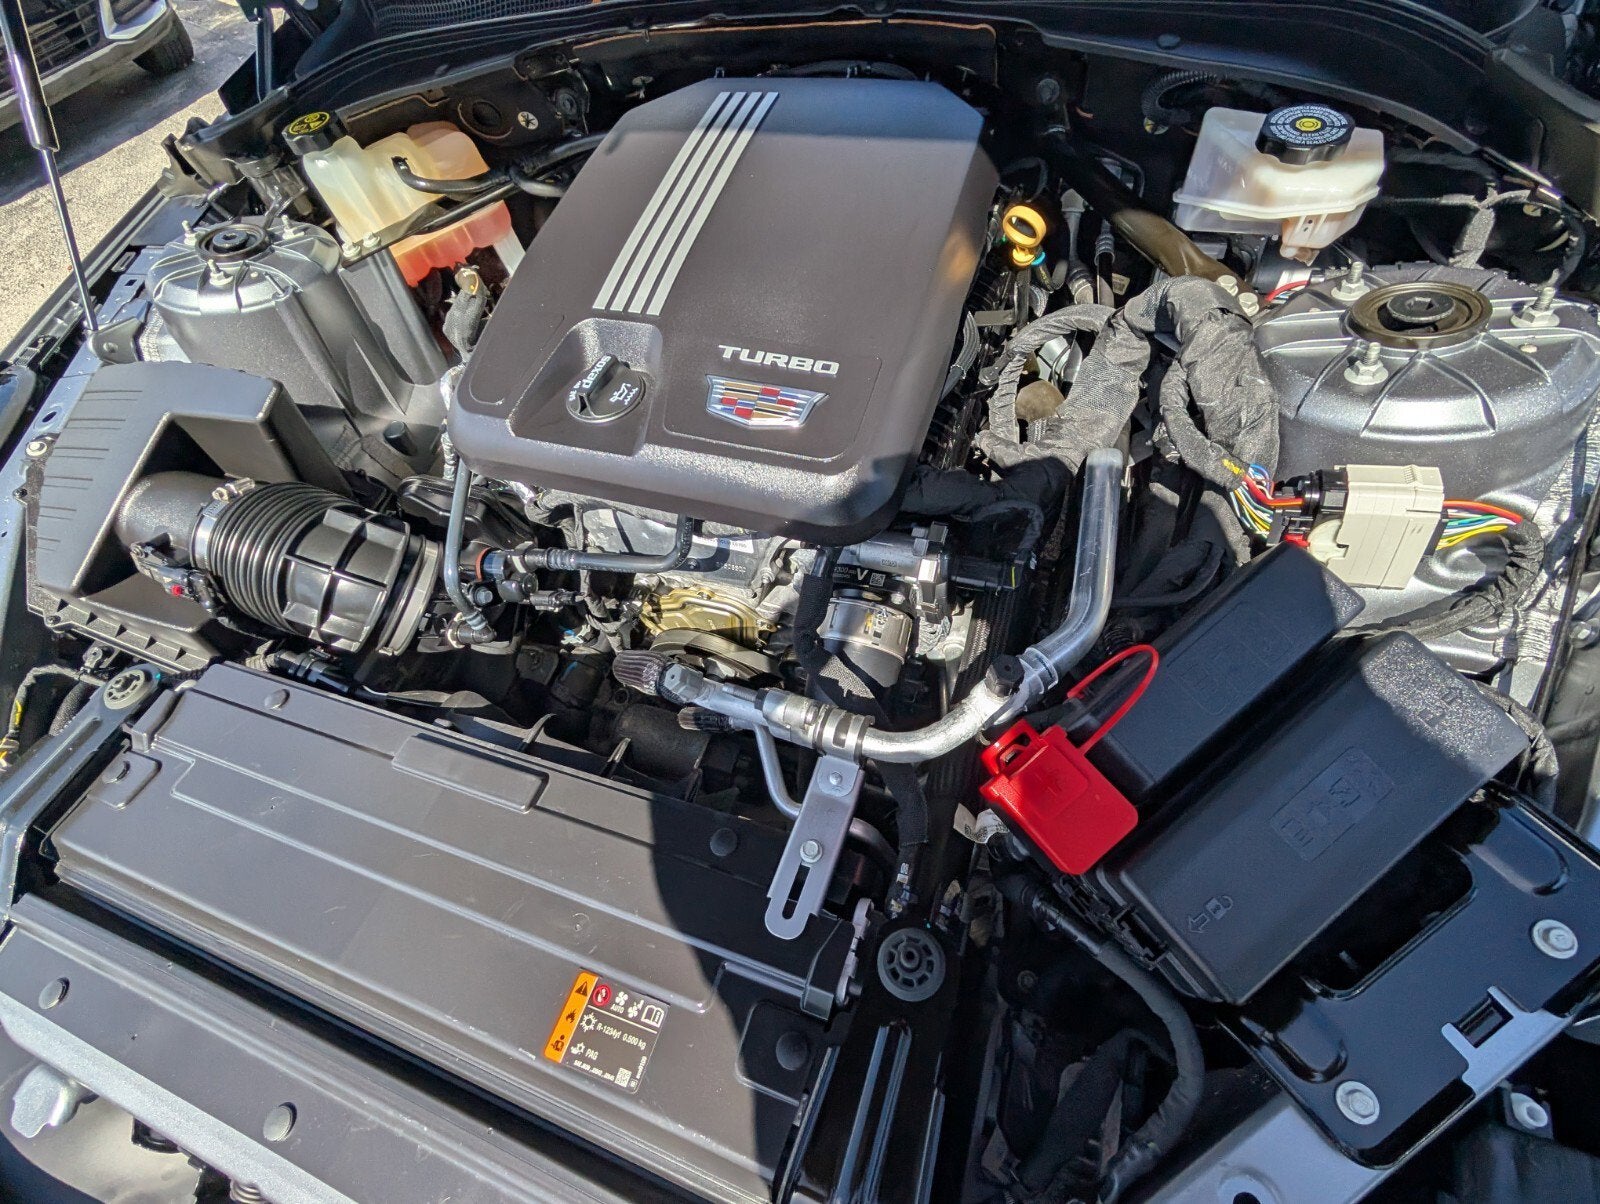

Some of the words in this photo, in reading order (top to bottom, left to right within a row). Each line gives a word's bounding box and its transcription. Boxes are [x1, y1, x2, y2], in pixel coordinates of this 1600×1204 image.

[718, 344, 840, 375] TURBO
[582, 355, 612, 389] dexos
[610, 1003, 625, 1014] AUTO
[639, 1039, 647, 1050] kg
[585, 1048, 599, 1060] PAG
